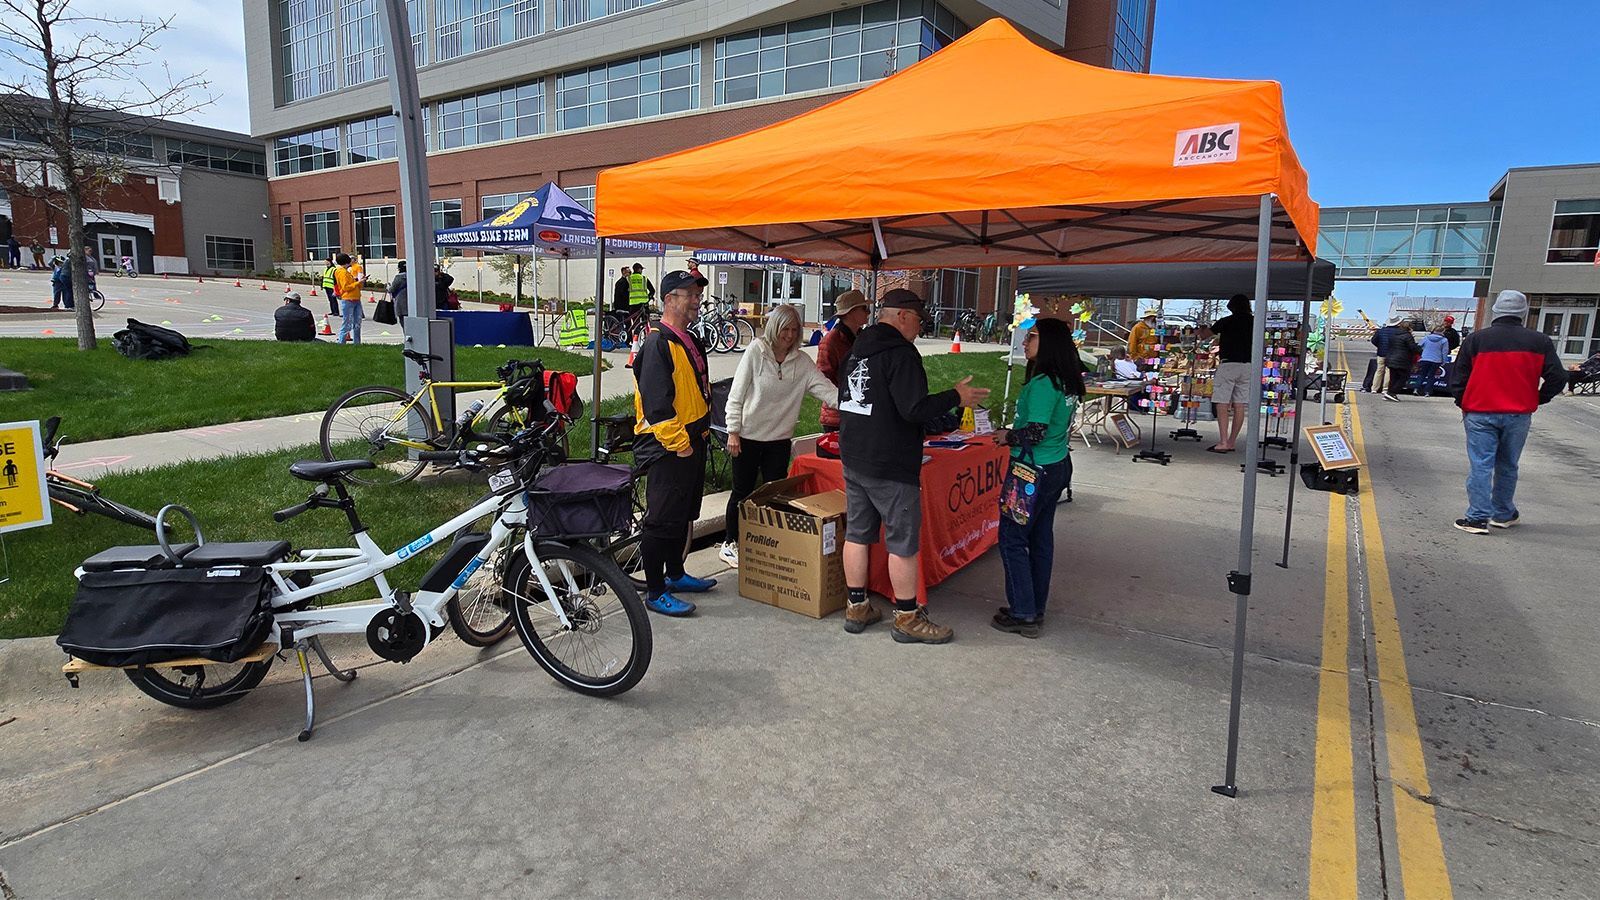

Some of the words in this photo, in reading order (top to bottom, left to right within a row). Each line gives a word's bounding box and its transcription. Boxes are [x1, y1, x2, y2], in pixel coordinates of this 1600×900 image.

[1180, 129, 1234, 155] ABC
[436, 230, 479, 244] MOUNTAIN
[480, 230, 502, 242] BIKE
[502, 228, 529, 242] TEAM
[612, 238, 653, 250] COMPOSITE
[696, 252, 736, 262] MOUNTAIN
[738, 252, 758, 262] BIKE
[977, 456, 1004, 496] LBK
[745, 531, 780, 548] ProRider
[777, 586, 799, 598] SEATTLE
[800, 592, 812, 602] USA
